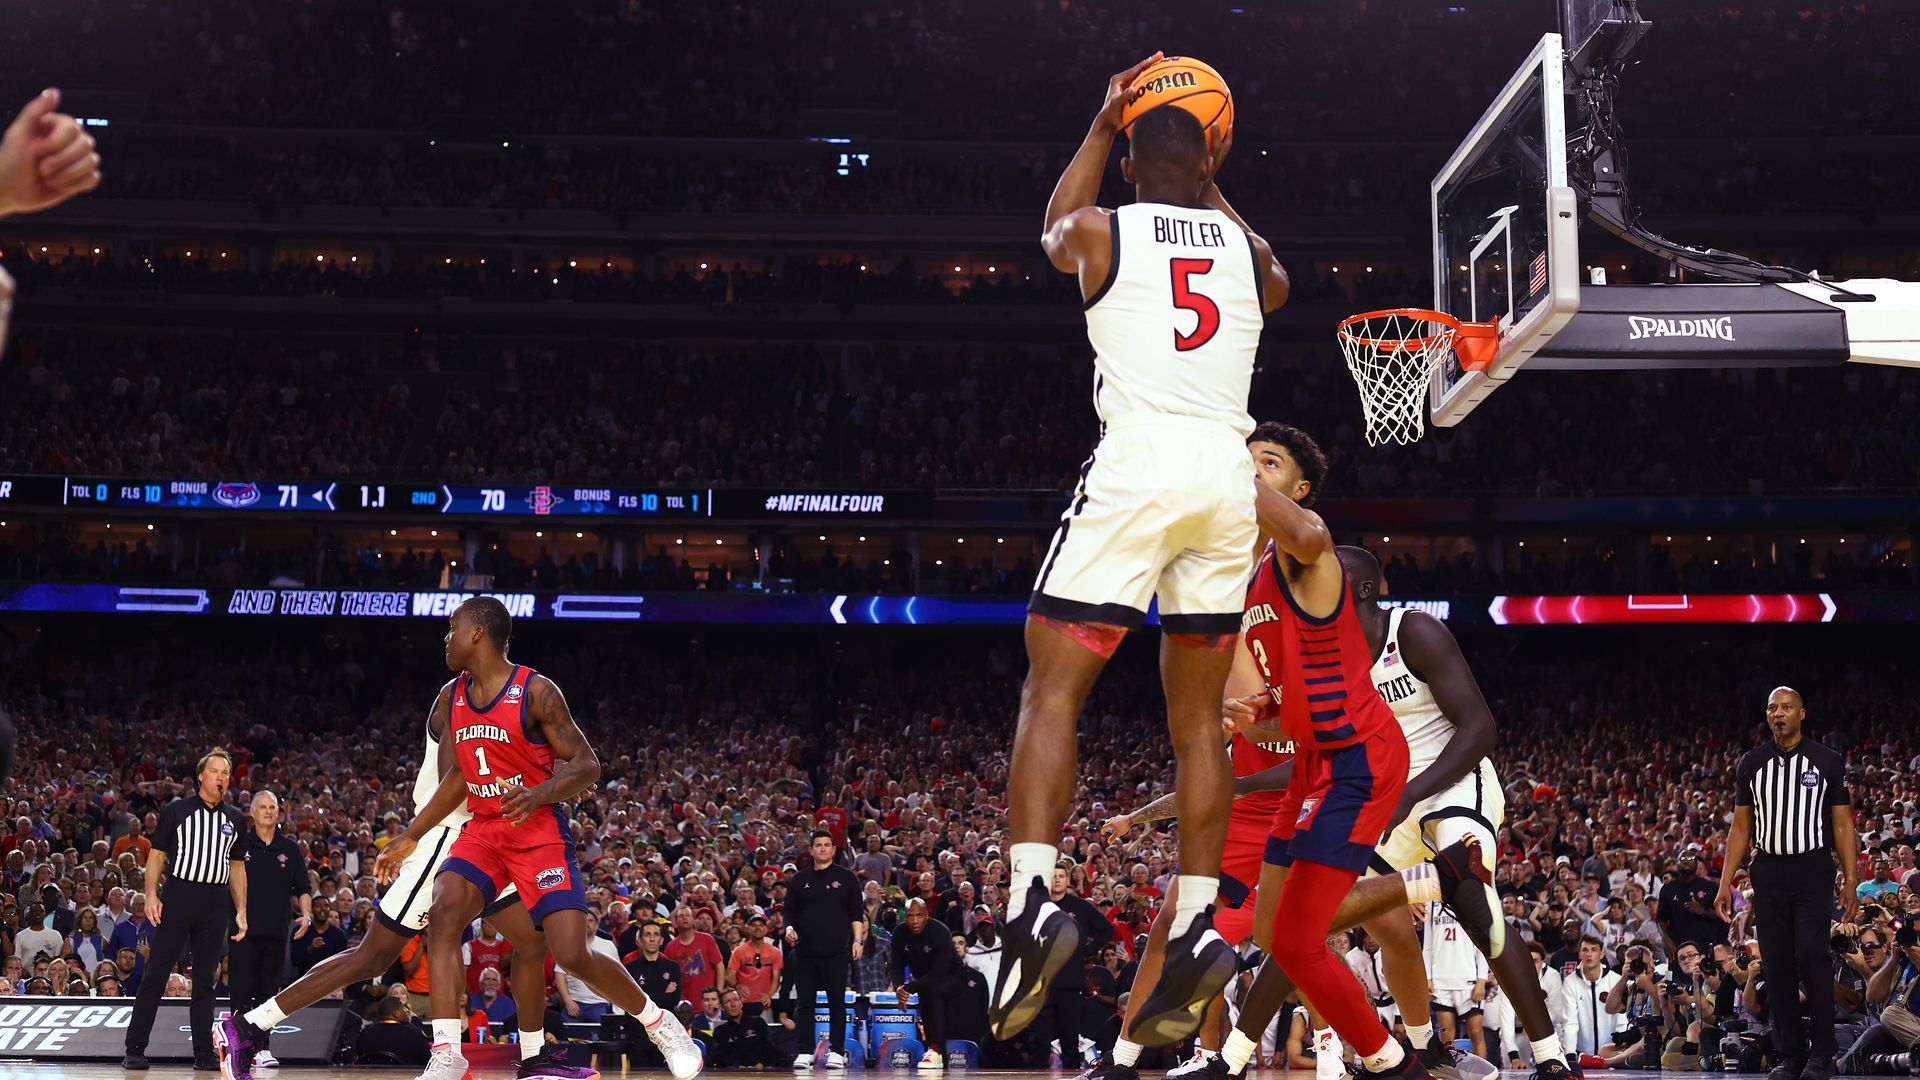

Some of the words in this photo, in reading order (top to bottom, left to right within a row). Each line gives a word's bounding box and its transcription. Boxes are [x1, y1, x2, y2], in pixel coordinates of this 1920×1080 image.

[1154, 216, 1226, 247] BUTLER
[1170, 257, 1220, 351] 5
[1628, 315, 1732, 341] SPALDING
[72, 486, 91, 498] TOL
[96, 484, 108, 501] 0
[121, 487, 140, 499] FLS
[145, 485, 161, 502] 10
[171, 482, 208, 494] BONUS
[278, 485, 298, 507] 71
[360, 486, 385, 508] 1.1
[411, 491, 436, 505] 2ND
[574, 489, 610, 501] BONUS
[481, 489, 506, 511] 70
[618, 496, 637, 508] FLS
[641, 494, 658, 511] 10
[666, 496, 685, 508] TOL
[691, 494, 698, 511] 1
[765, 495, 884, 512] #MFINALFOUR
[228, 590, 275, 614] AND
[280, 591, 336, 615] THEN
[341, 592, 408, 616] THERE
[1240, 603, 1279, 634] ORIDA
[1252, 638, 1271, 677] 2
[1378, 674, 1416, 703] STATE
[455, 724, 511, 744] FLORIDA
[475, 746, 491, 776] 1
[466, 773, 524, 798] ATLANC
[1444, 927, 1457, 942] 21
[0, 1005, 134, 1028] DIEGO
[875, 1015, 914, 1023] POWERADE
